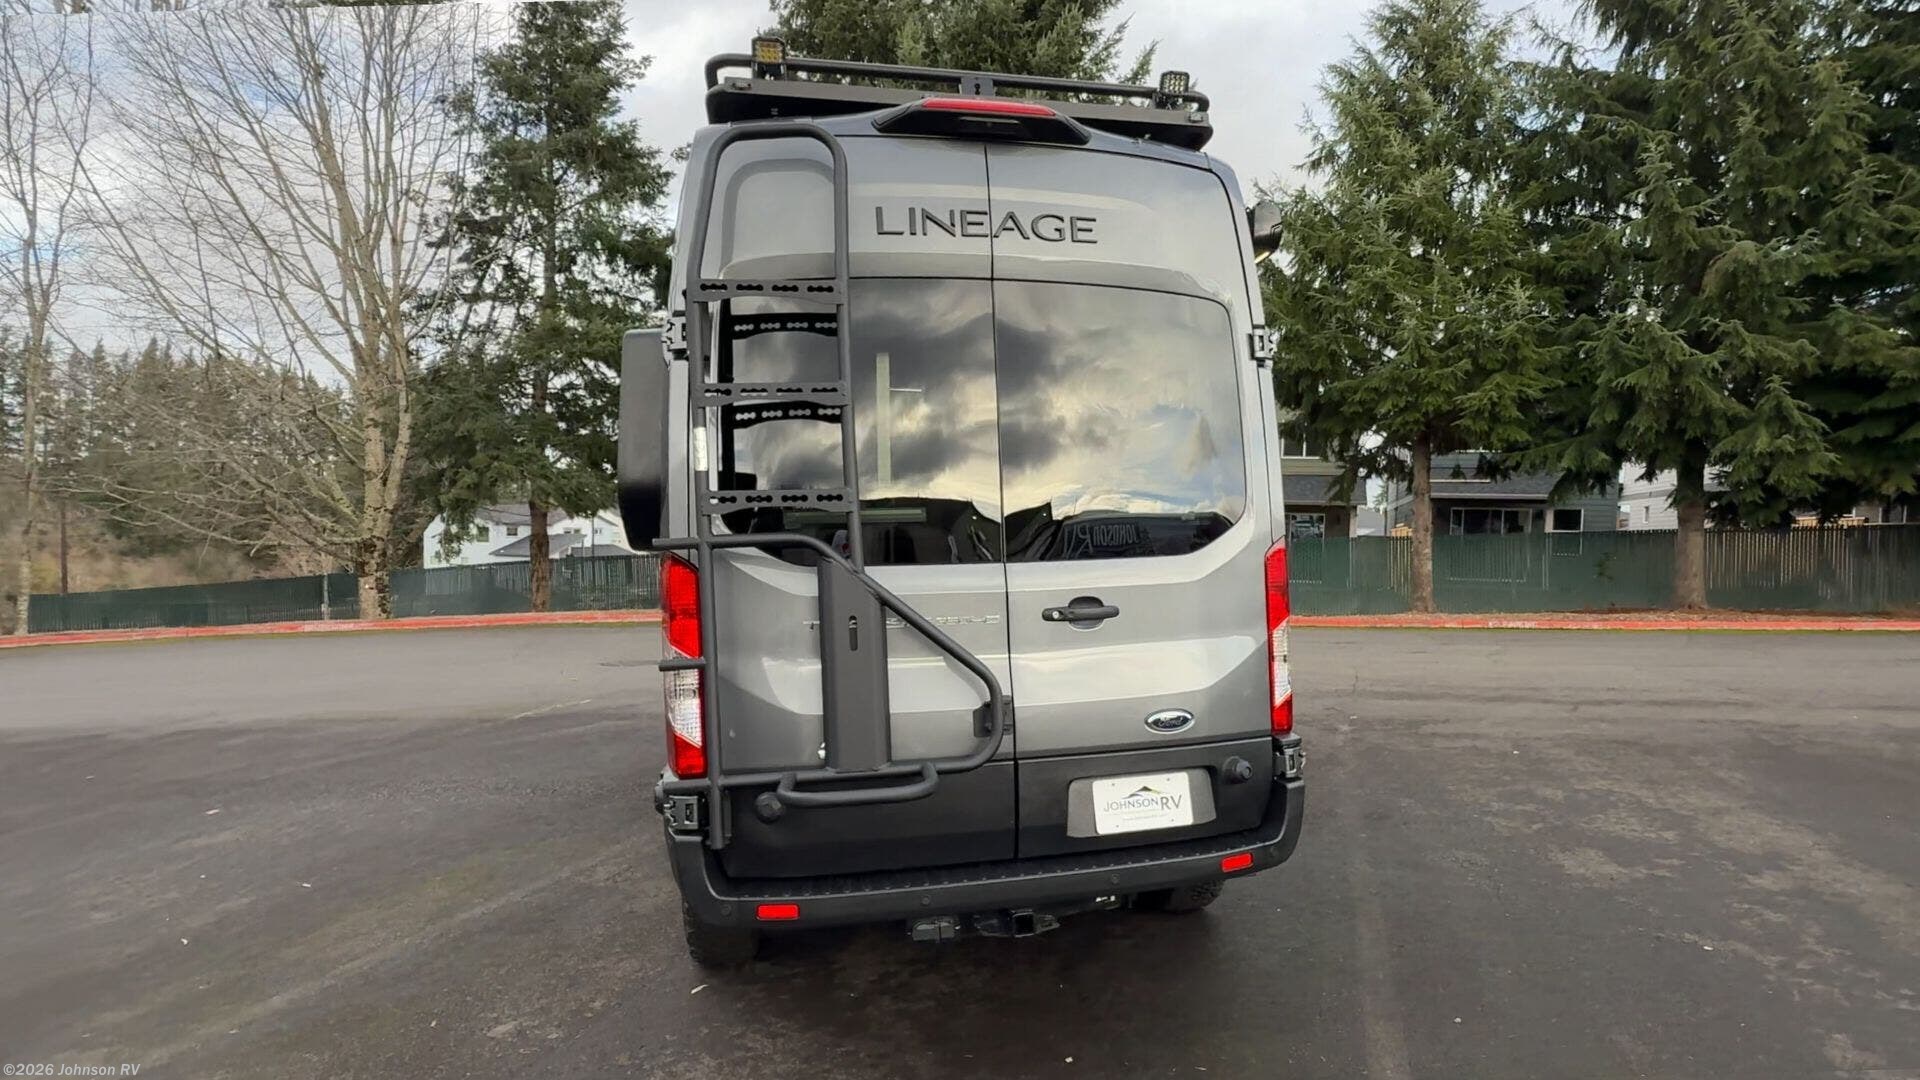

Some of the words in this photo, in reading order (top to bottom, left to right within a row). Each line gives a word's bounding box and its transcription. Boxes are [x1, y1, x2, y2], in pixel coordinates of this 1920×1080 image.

[875, 206, 1098, 244] LINEAGE
[1103, 797, 1159, 812] JOHNSON
[1160, 794, 1182, 811] RV
